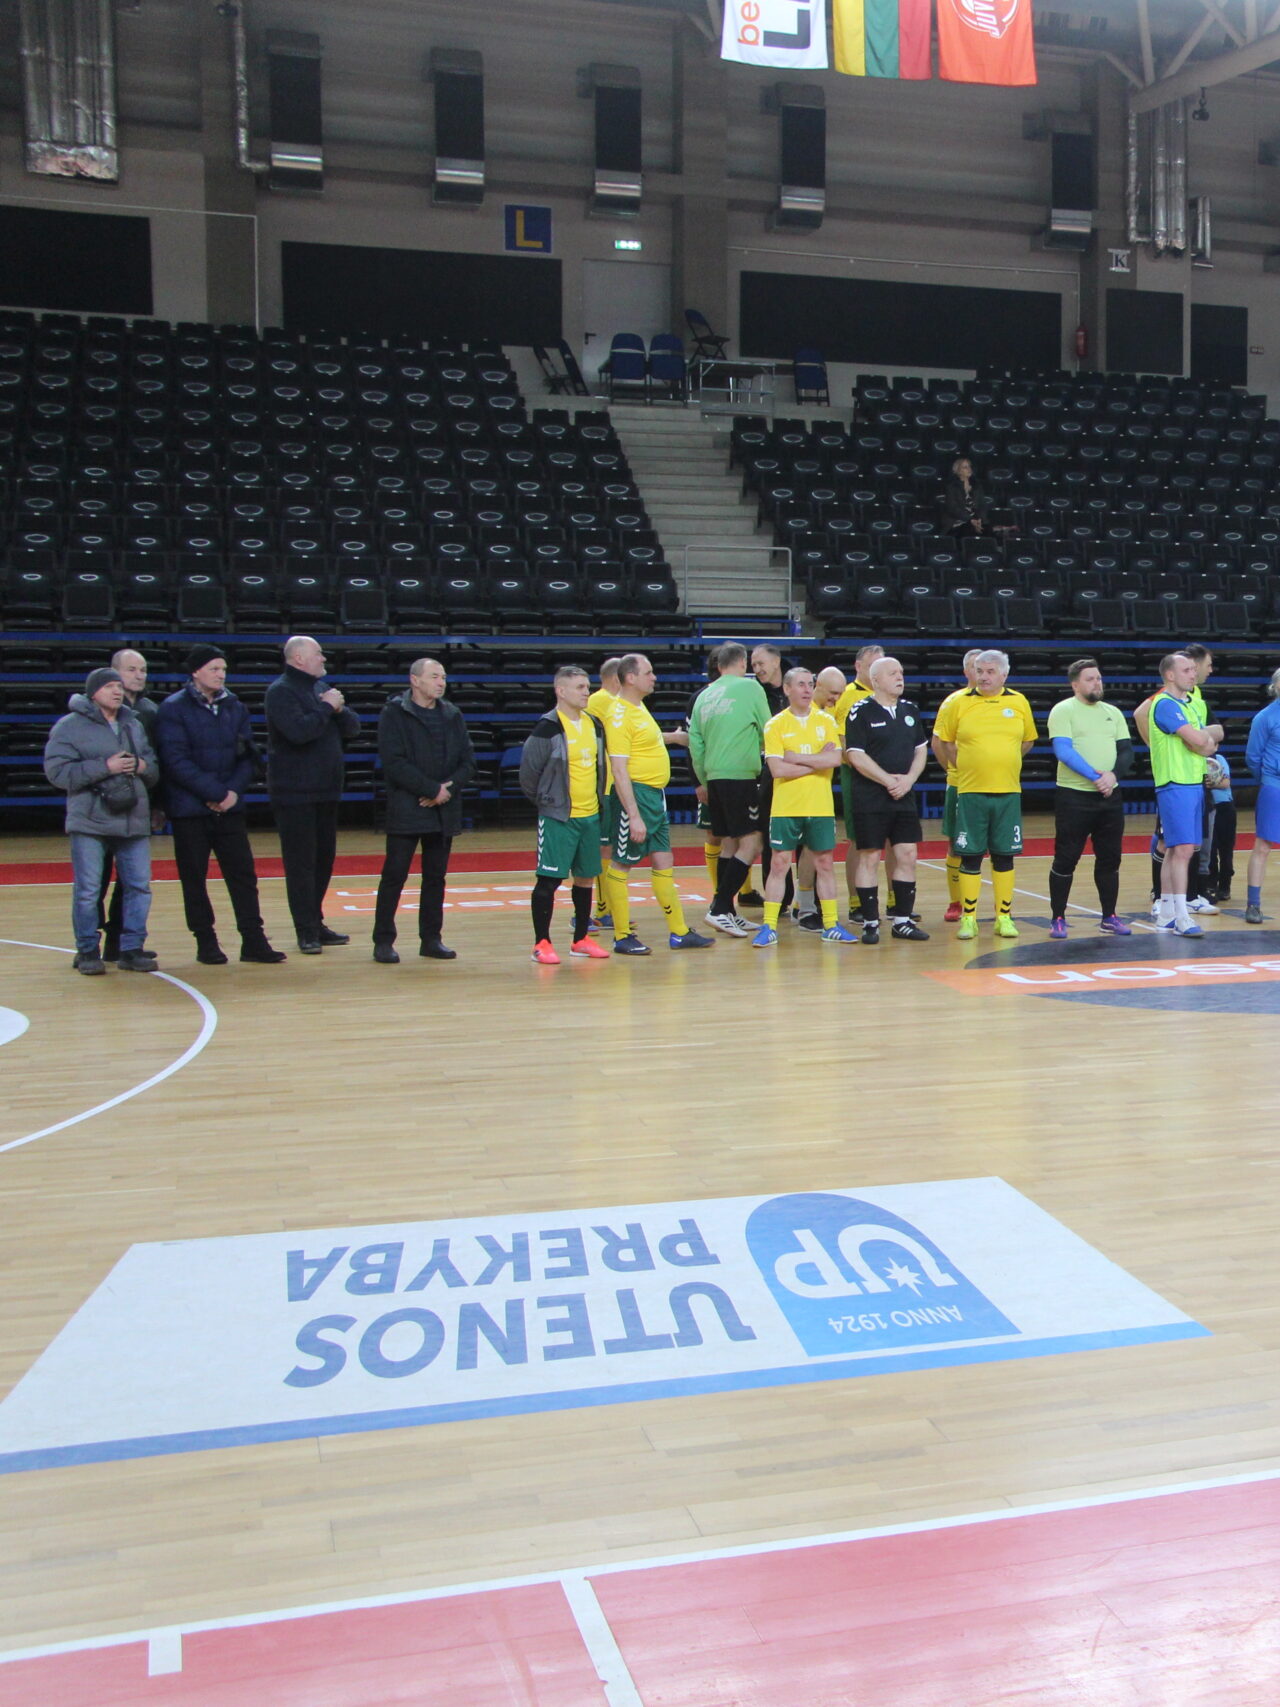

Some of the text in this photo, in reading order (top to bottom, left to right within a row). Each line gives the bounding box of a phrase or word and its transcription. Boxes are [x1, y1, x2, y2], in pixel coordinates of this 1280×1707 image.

[763, 0, 811, 49] L
[515, 209, 543, 249] L
[1013, 825, 1021, 843] 3
[285, 1218, 722, 1303] PREKYBA
[774, 1223, 959, 1299] UP
[282, 1281, 758, 1389] UTENOS
[828, 1304, 963, 1334] ANNO 1924
